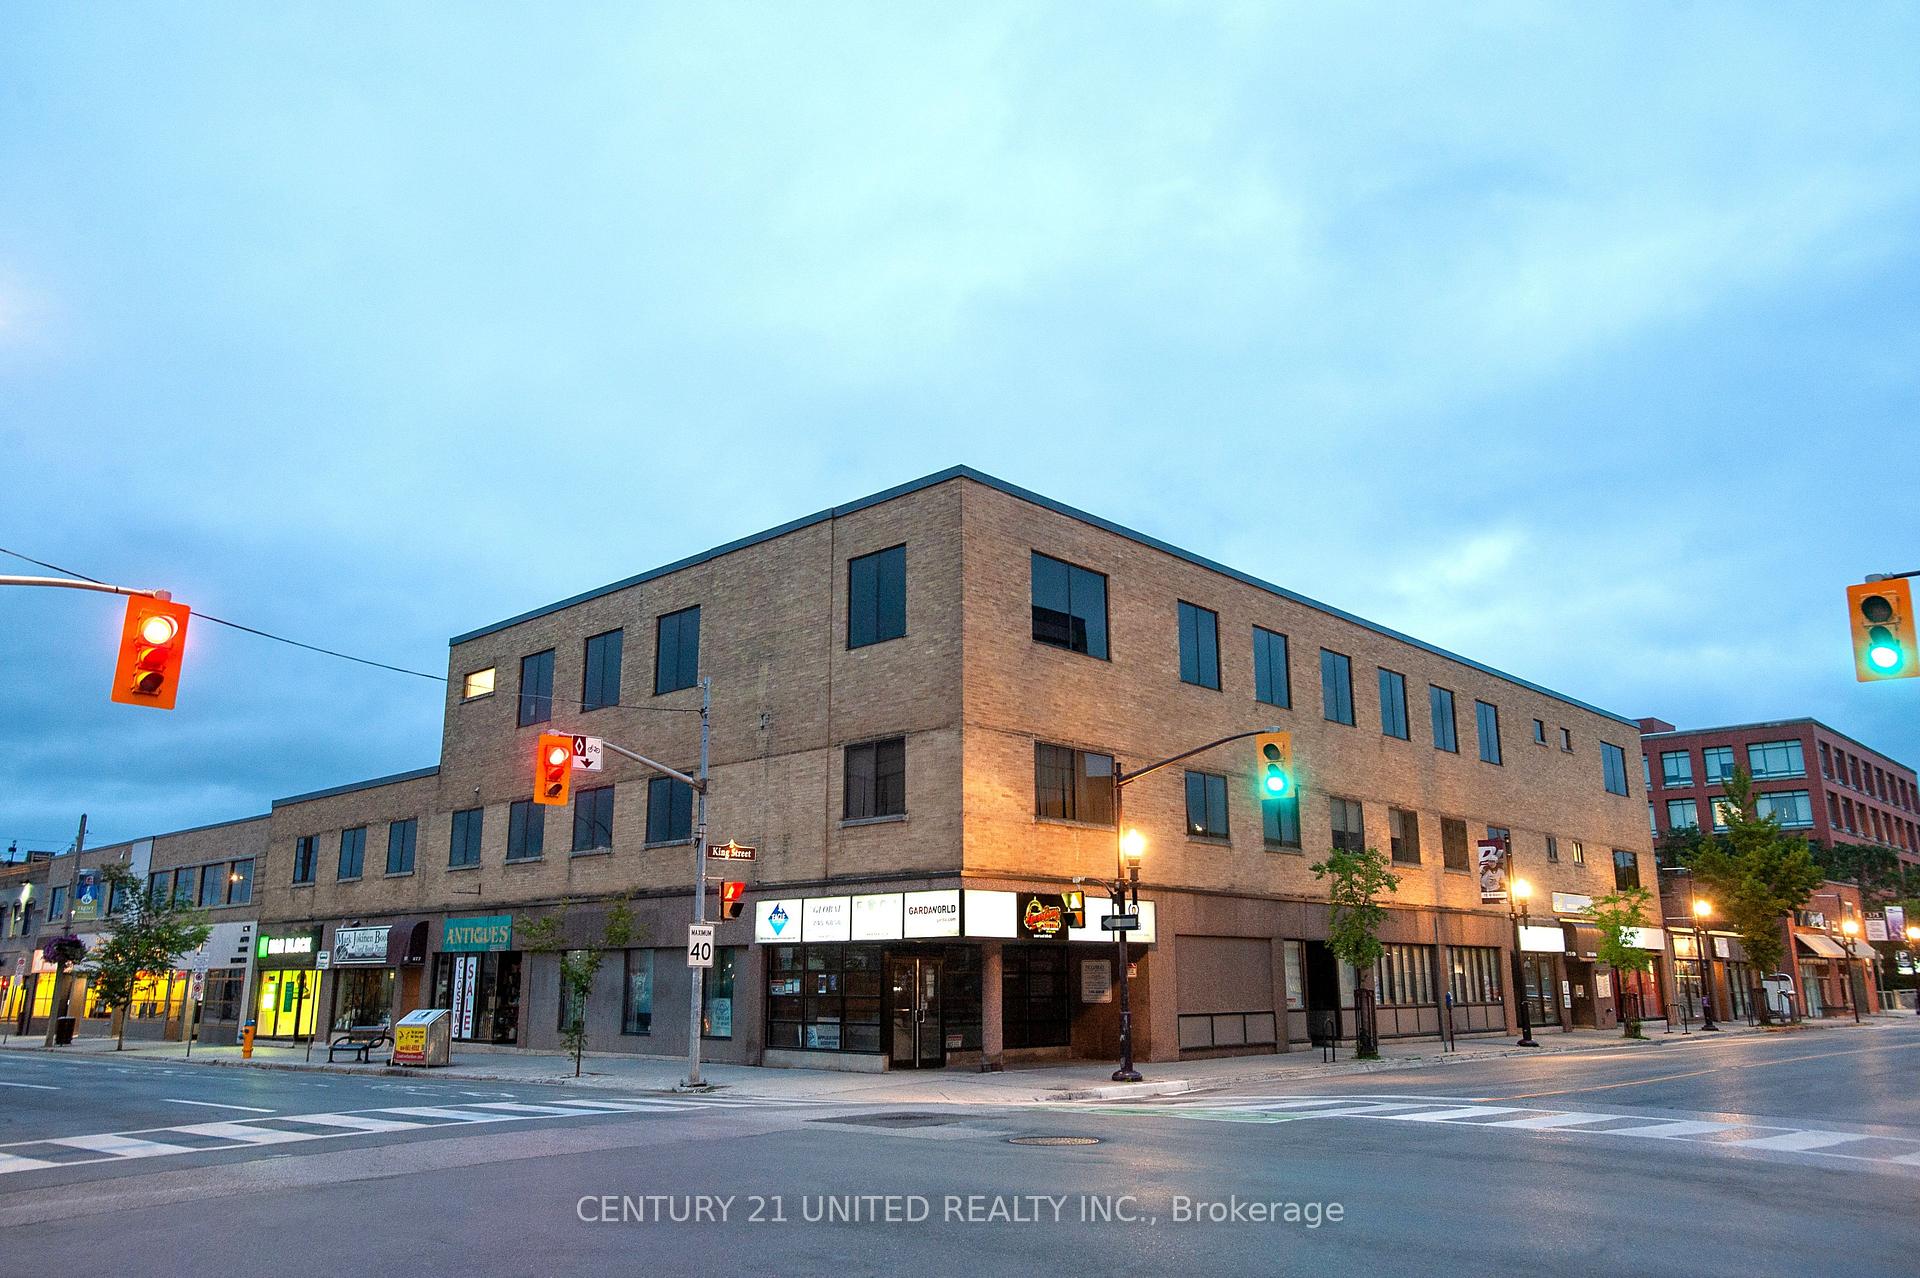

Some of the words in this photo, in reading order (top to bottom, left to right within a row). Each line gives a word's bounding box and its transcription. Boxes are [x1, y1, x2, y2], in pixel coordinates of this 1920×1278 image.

[712, 847, 730, 860] King
[730, 848, 752, 858] Street
[908, 904, 956, 915] GARDAWORLD
[335, 932, 352, 945] Mark
[446, 925, 509, 944] ANTIQUES
[690, 942, 711, 961] 40
[453, 959, 463, 1035] CLOSING
[464, 964, 474, 1031] SALE
